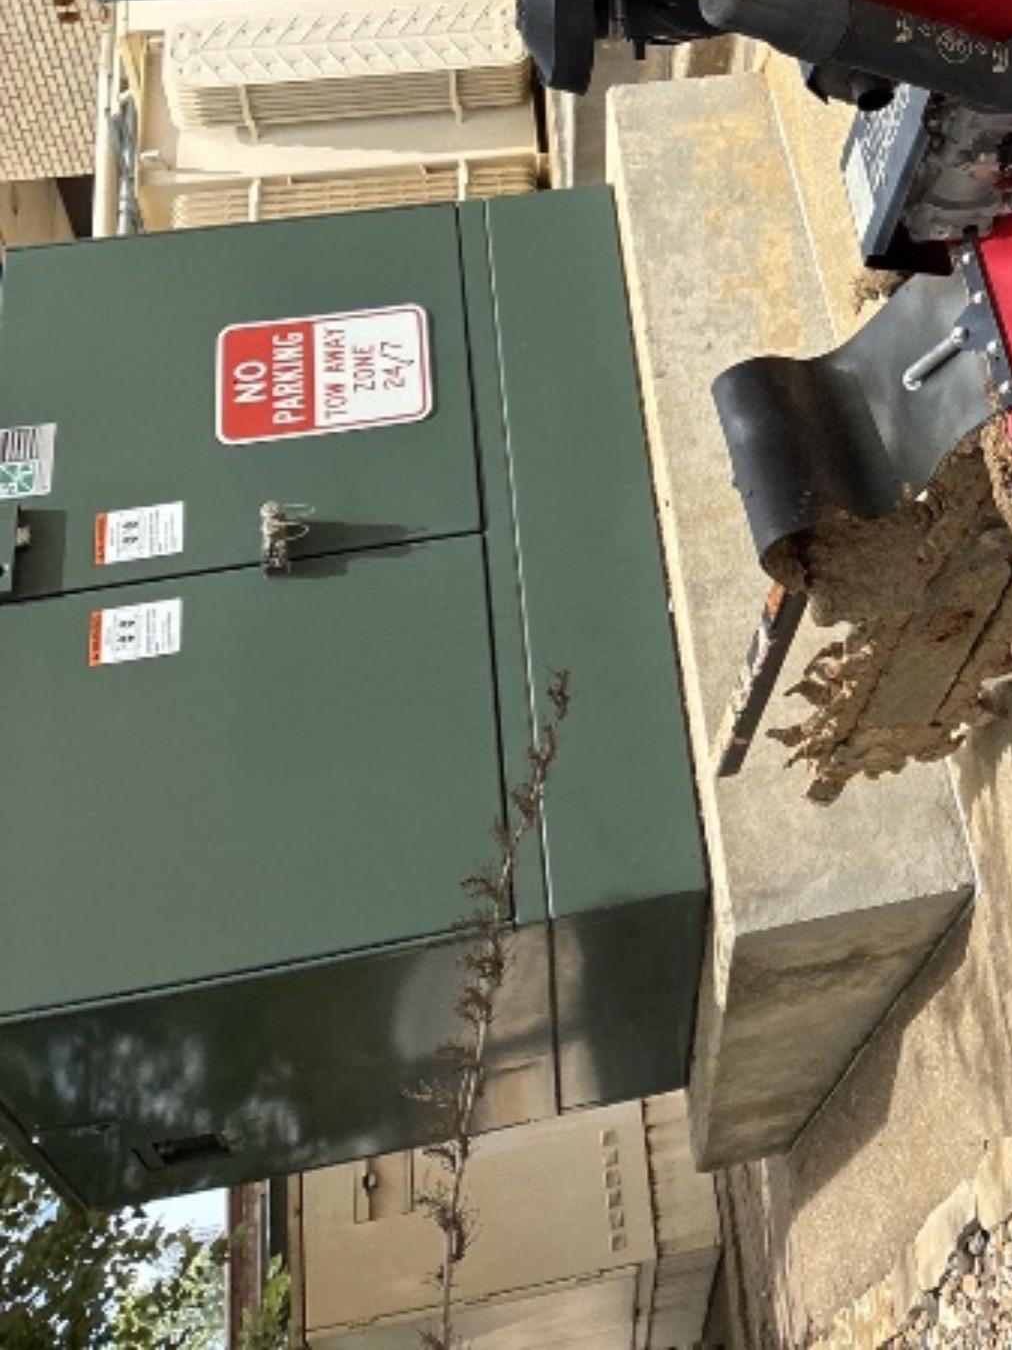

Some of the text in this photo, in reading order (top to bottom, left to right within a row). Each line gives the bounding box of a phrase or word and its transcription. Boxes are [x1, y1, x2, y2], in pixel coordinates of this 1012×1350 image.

[233, 360, 268, 403] NO
[272, 331, 306, 425] PARKING
[323, 327, 349, 421] TOW AWAY
[352, 345, 376, 394] ZONE
[380, 341, 415, 391] 24/7
